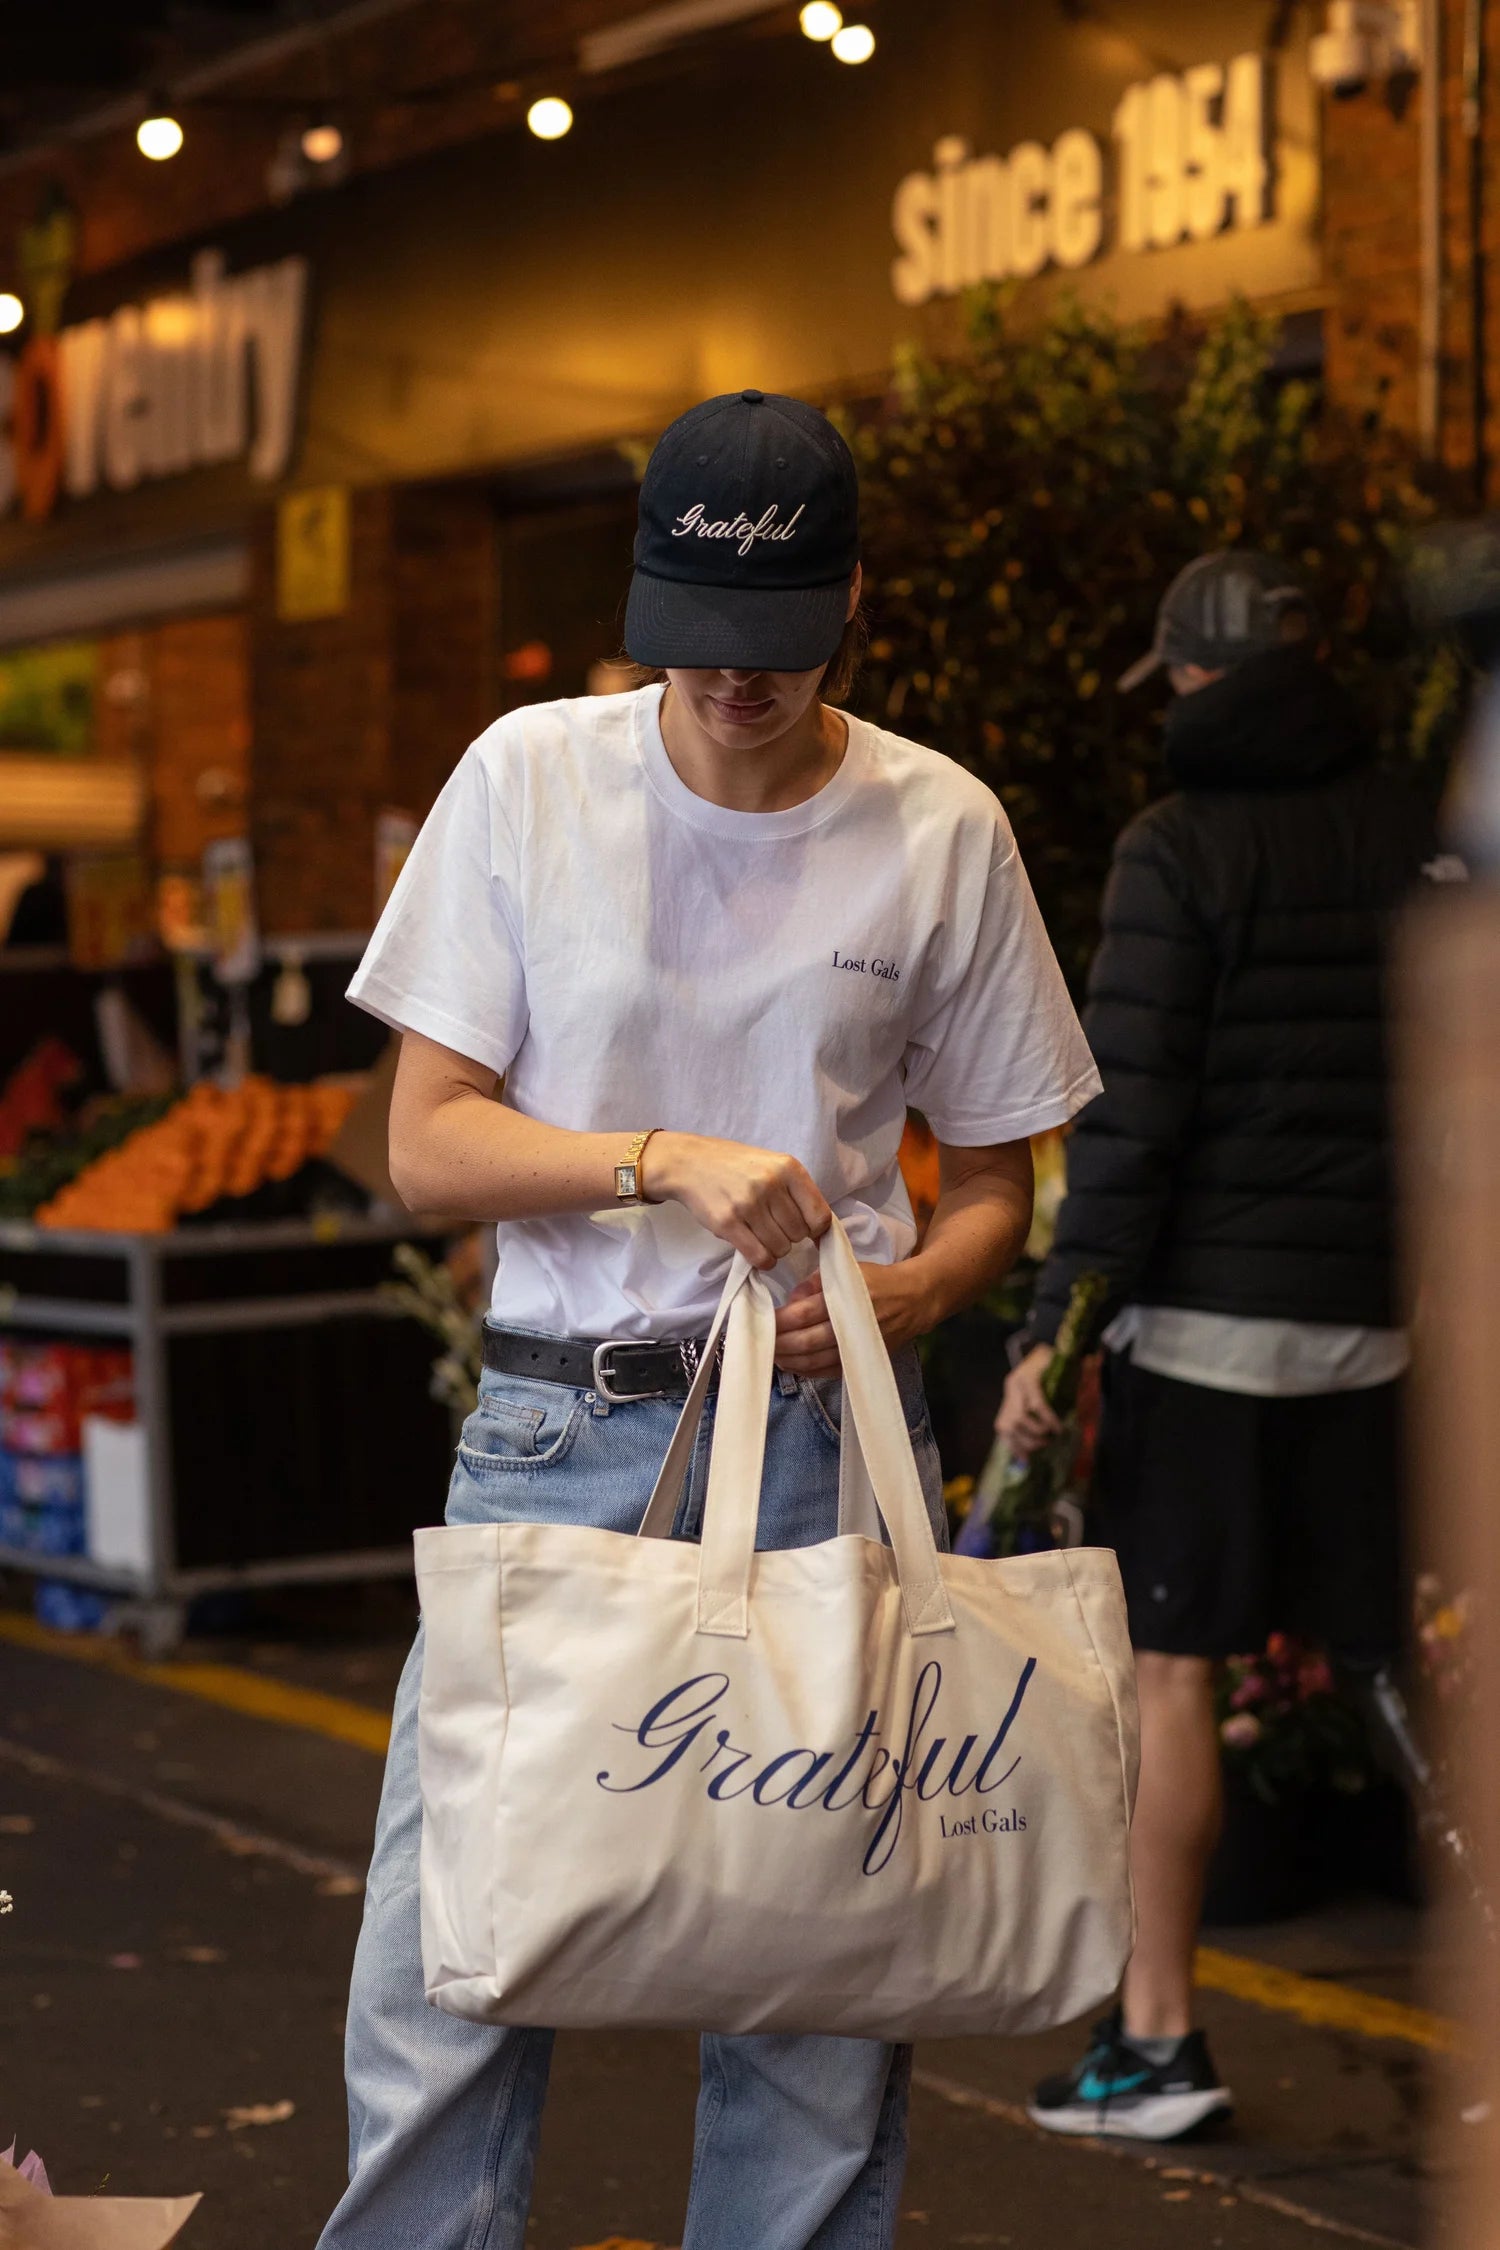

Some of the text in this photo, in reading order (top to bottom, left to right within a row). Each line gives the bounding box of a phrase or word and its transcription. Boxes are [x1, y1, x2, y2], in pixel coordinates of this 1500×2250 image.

[892, 129, 1101, 303] since
[671, 503, 806, 556] Grateful
[832, 951, 901, 981] Lost Gals
[597, 1657, 1037, 1876] Grateful
[940, 1808, 1027, 1838] Lost Gals
